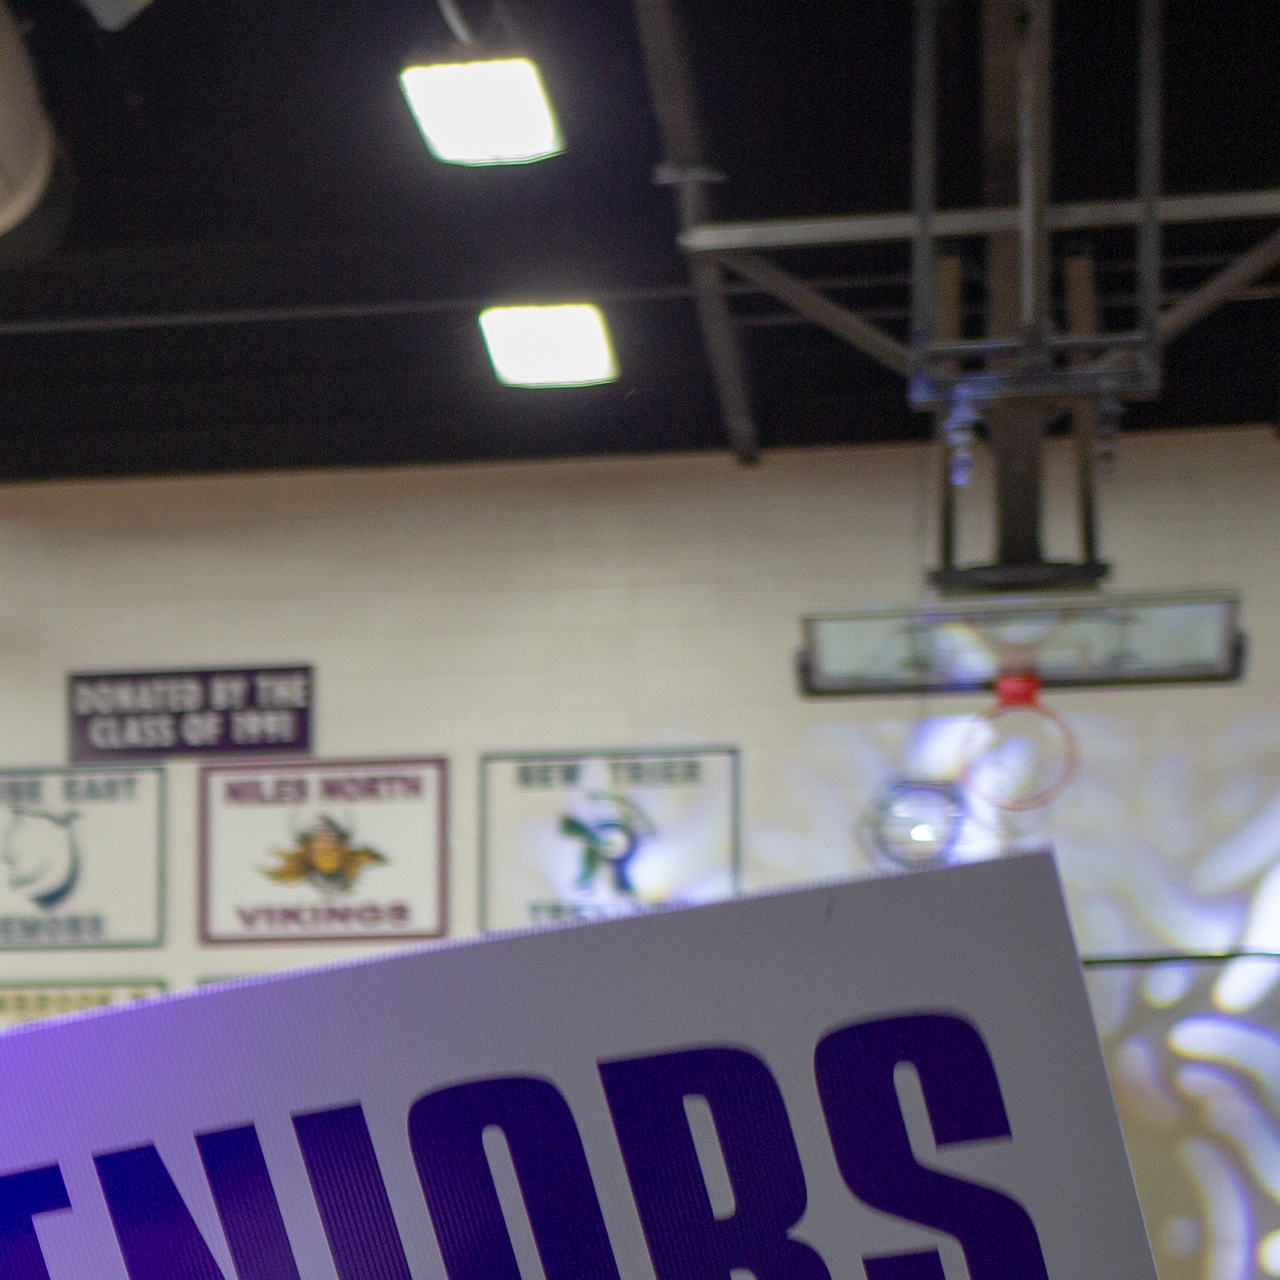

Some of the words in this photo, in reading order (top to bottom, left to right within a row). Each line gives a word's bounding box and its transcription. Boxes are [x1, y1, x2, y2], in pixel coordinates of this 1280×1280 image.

[75, 678, 203, 715] DONATED
[210, 675, 248, 710] BY
[255, 672, 307, 707] THE
[89, 713, 176, 749] CLASS
[182, 710, 223, 746] OF
[516, 764, 581, 788] NEW
[608, 760, 702, 787] TRIER
[64, 776, 138, 802] EAST
[223, 781, 308, 804] NILES
[320, 776, 423, 801] NORTH
[235, 905, 409, 932] VIKINGS
